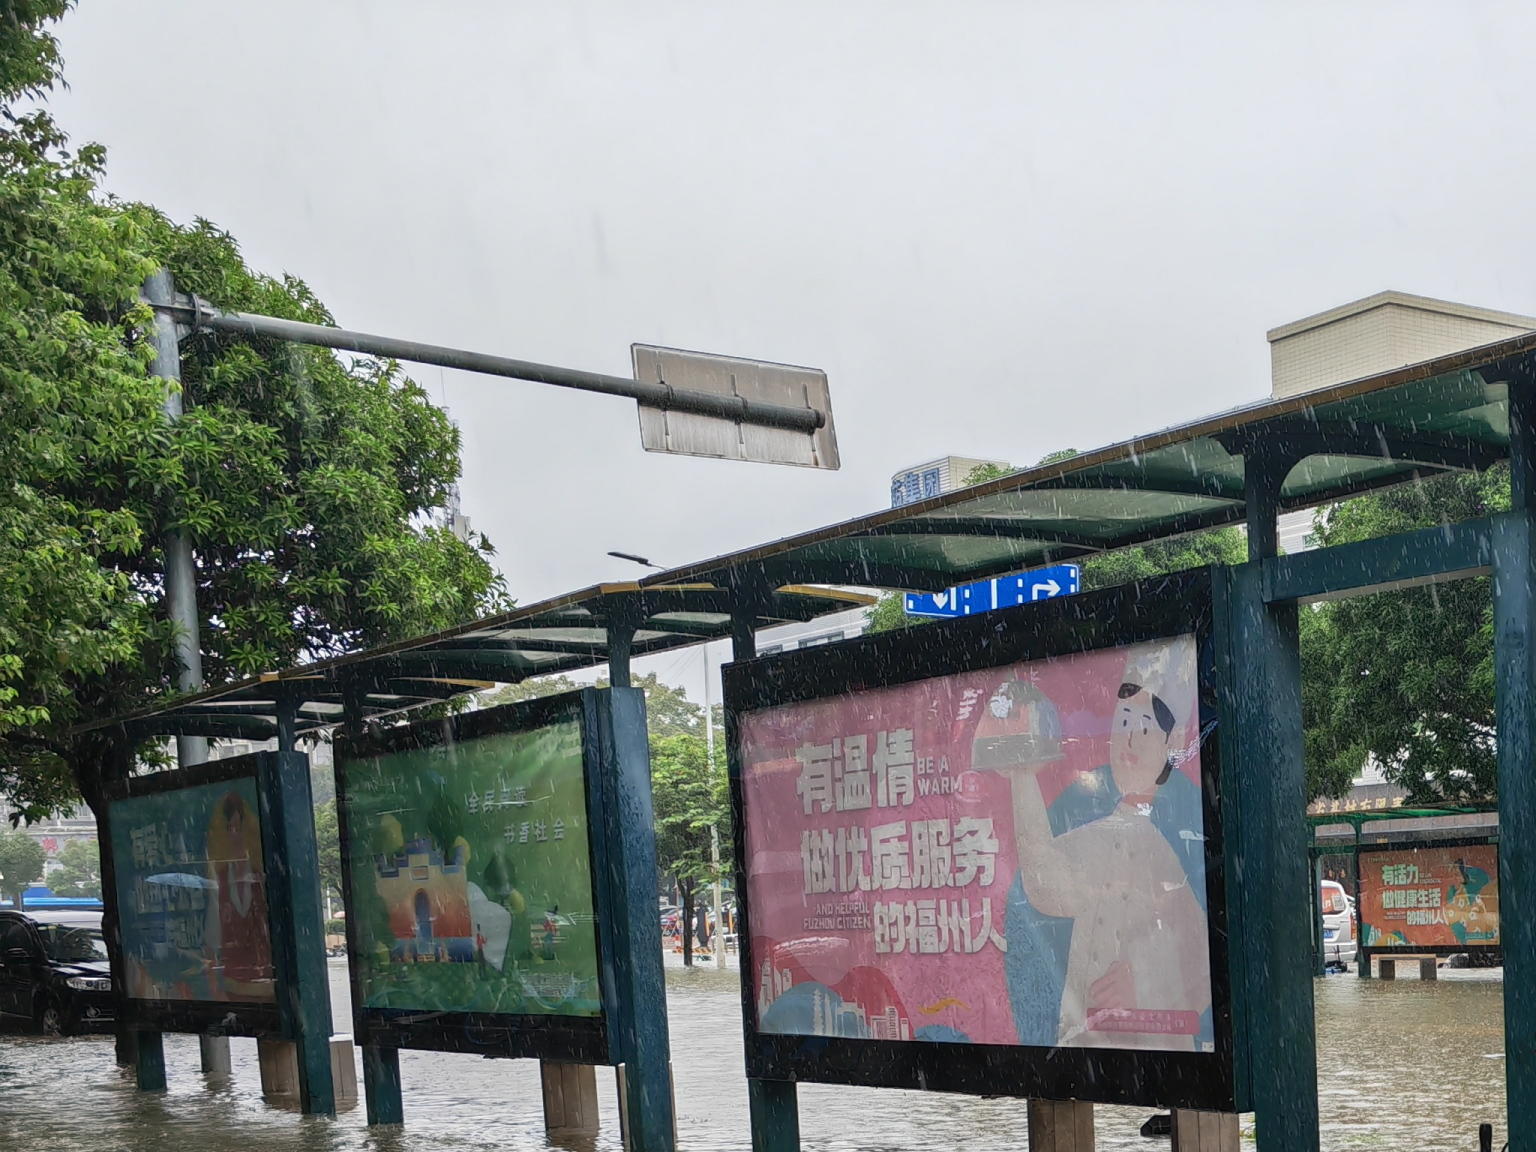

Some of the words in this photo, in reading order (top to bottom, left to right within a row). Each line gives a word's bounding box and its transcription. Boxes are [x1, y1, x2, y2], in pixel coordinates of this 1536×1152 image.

[795, 727, 915, 815] 有温情
[917, 756, 934, 775] BE
[938, 755, 949, 773] A
[918, 776, 964, 797] WARM
[503, 817, 566, 843] 书香社会
[801, 816, 1000, 895] 做优质服务
[1382, 864, 1419, 886] 有活力
[873, 897, 1008, 954] 的福州人
